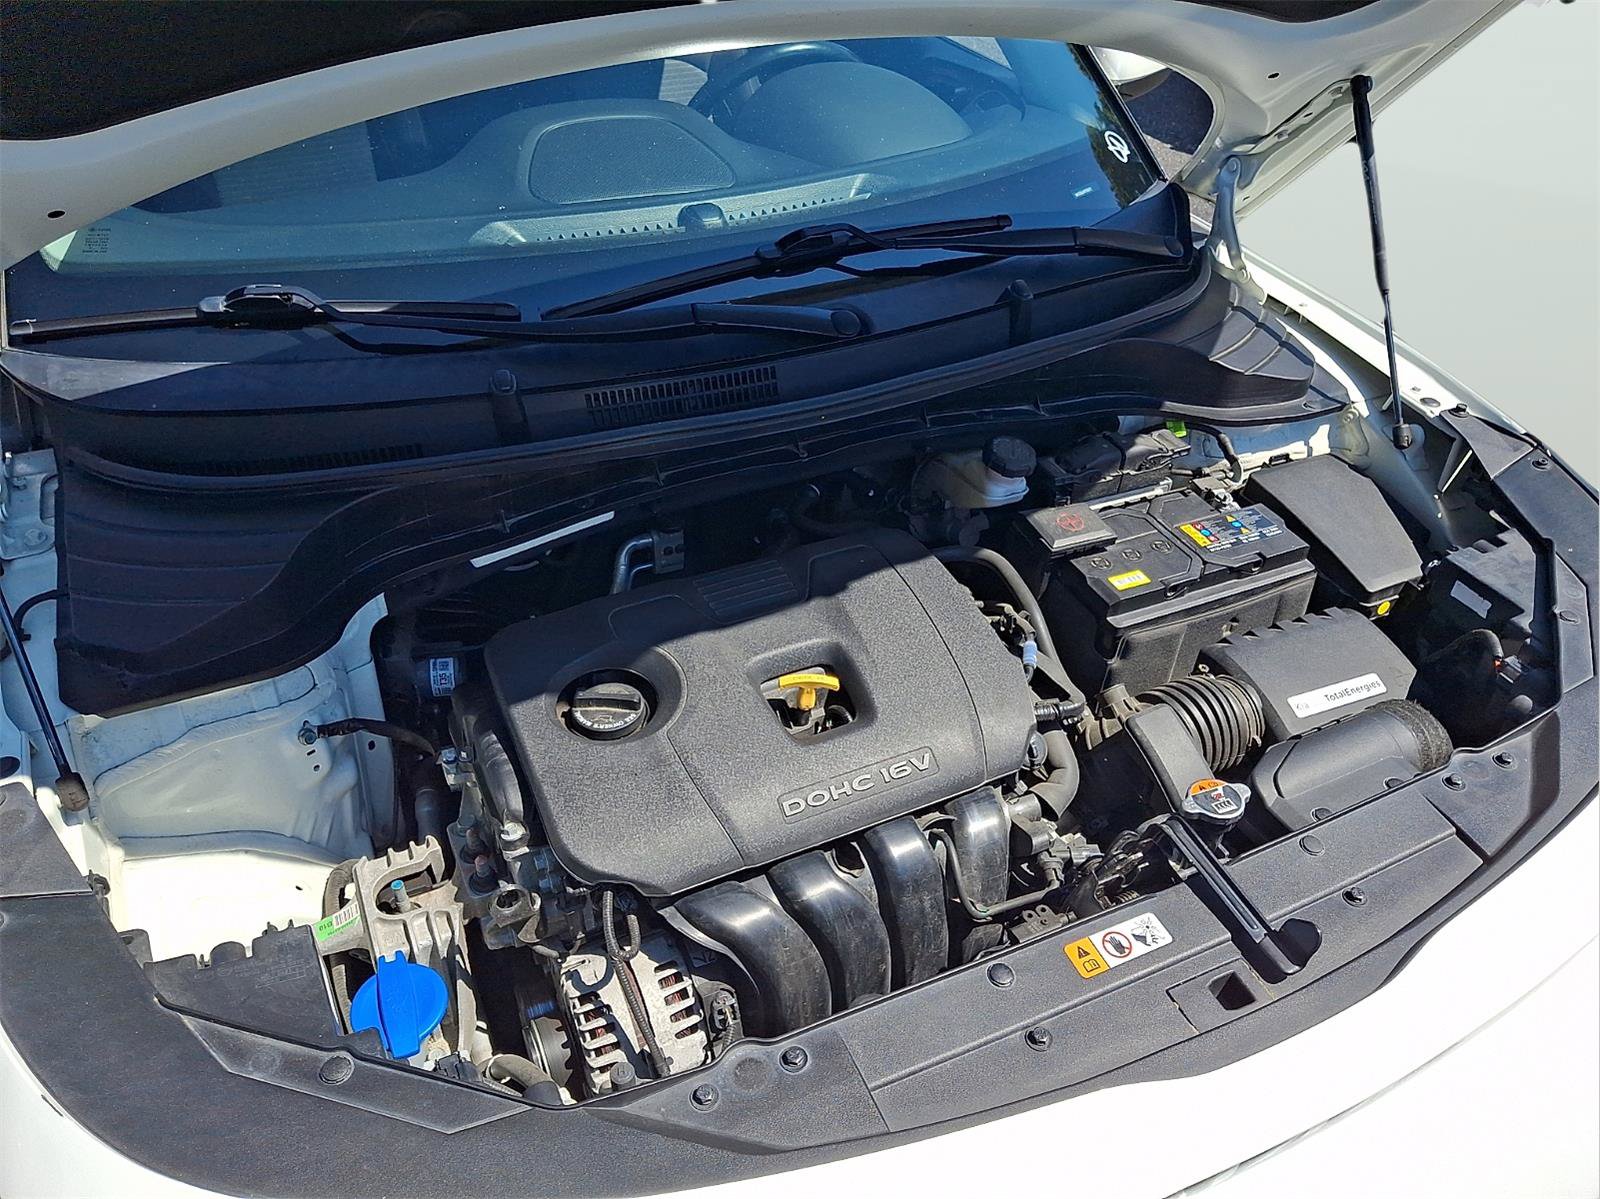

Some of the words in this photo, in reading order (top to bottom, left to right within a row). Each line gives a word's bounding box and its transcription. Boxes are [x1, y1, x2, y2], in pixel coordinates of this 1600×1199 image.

[1324, 680, 1381, 702] TotalEnergies
[782, 774, 875, 817] DOHC
[879, 753, 930, 783] 16V
